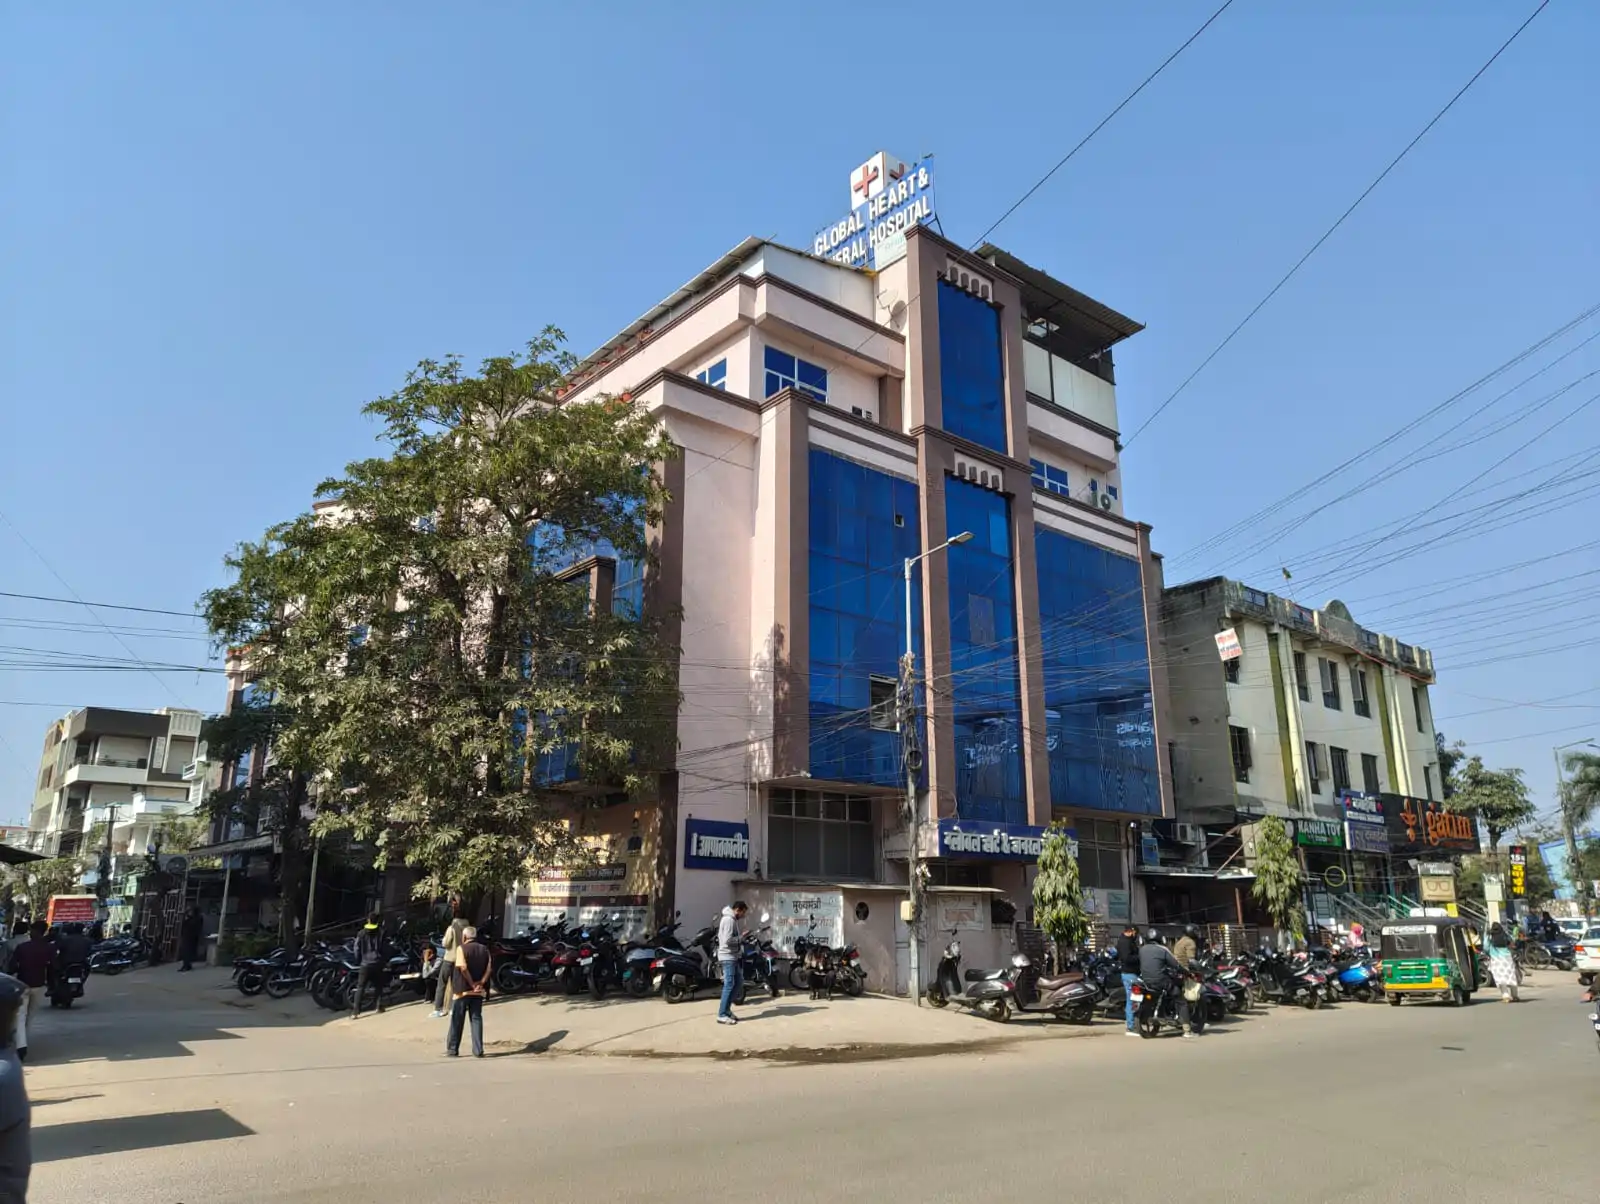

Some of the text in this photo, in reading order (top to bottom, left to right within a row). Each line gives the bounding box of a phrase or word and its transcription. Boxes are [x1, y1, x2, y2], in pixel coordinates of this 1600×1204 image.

[814, 210, 866, 256] GLOBAL
[868, 174, 918, 221] HEART
[869, 195, 931, 249] HOSPITAL
[1001, 832, 1010, 854] &
[1009, 836, 1042, 855] जनरल
